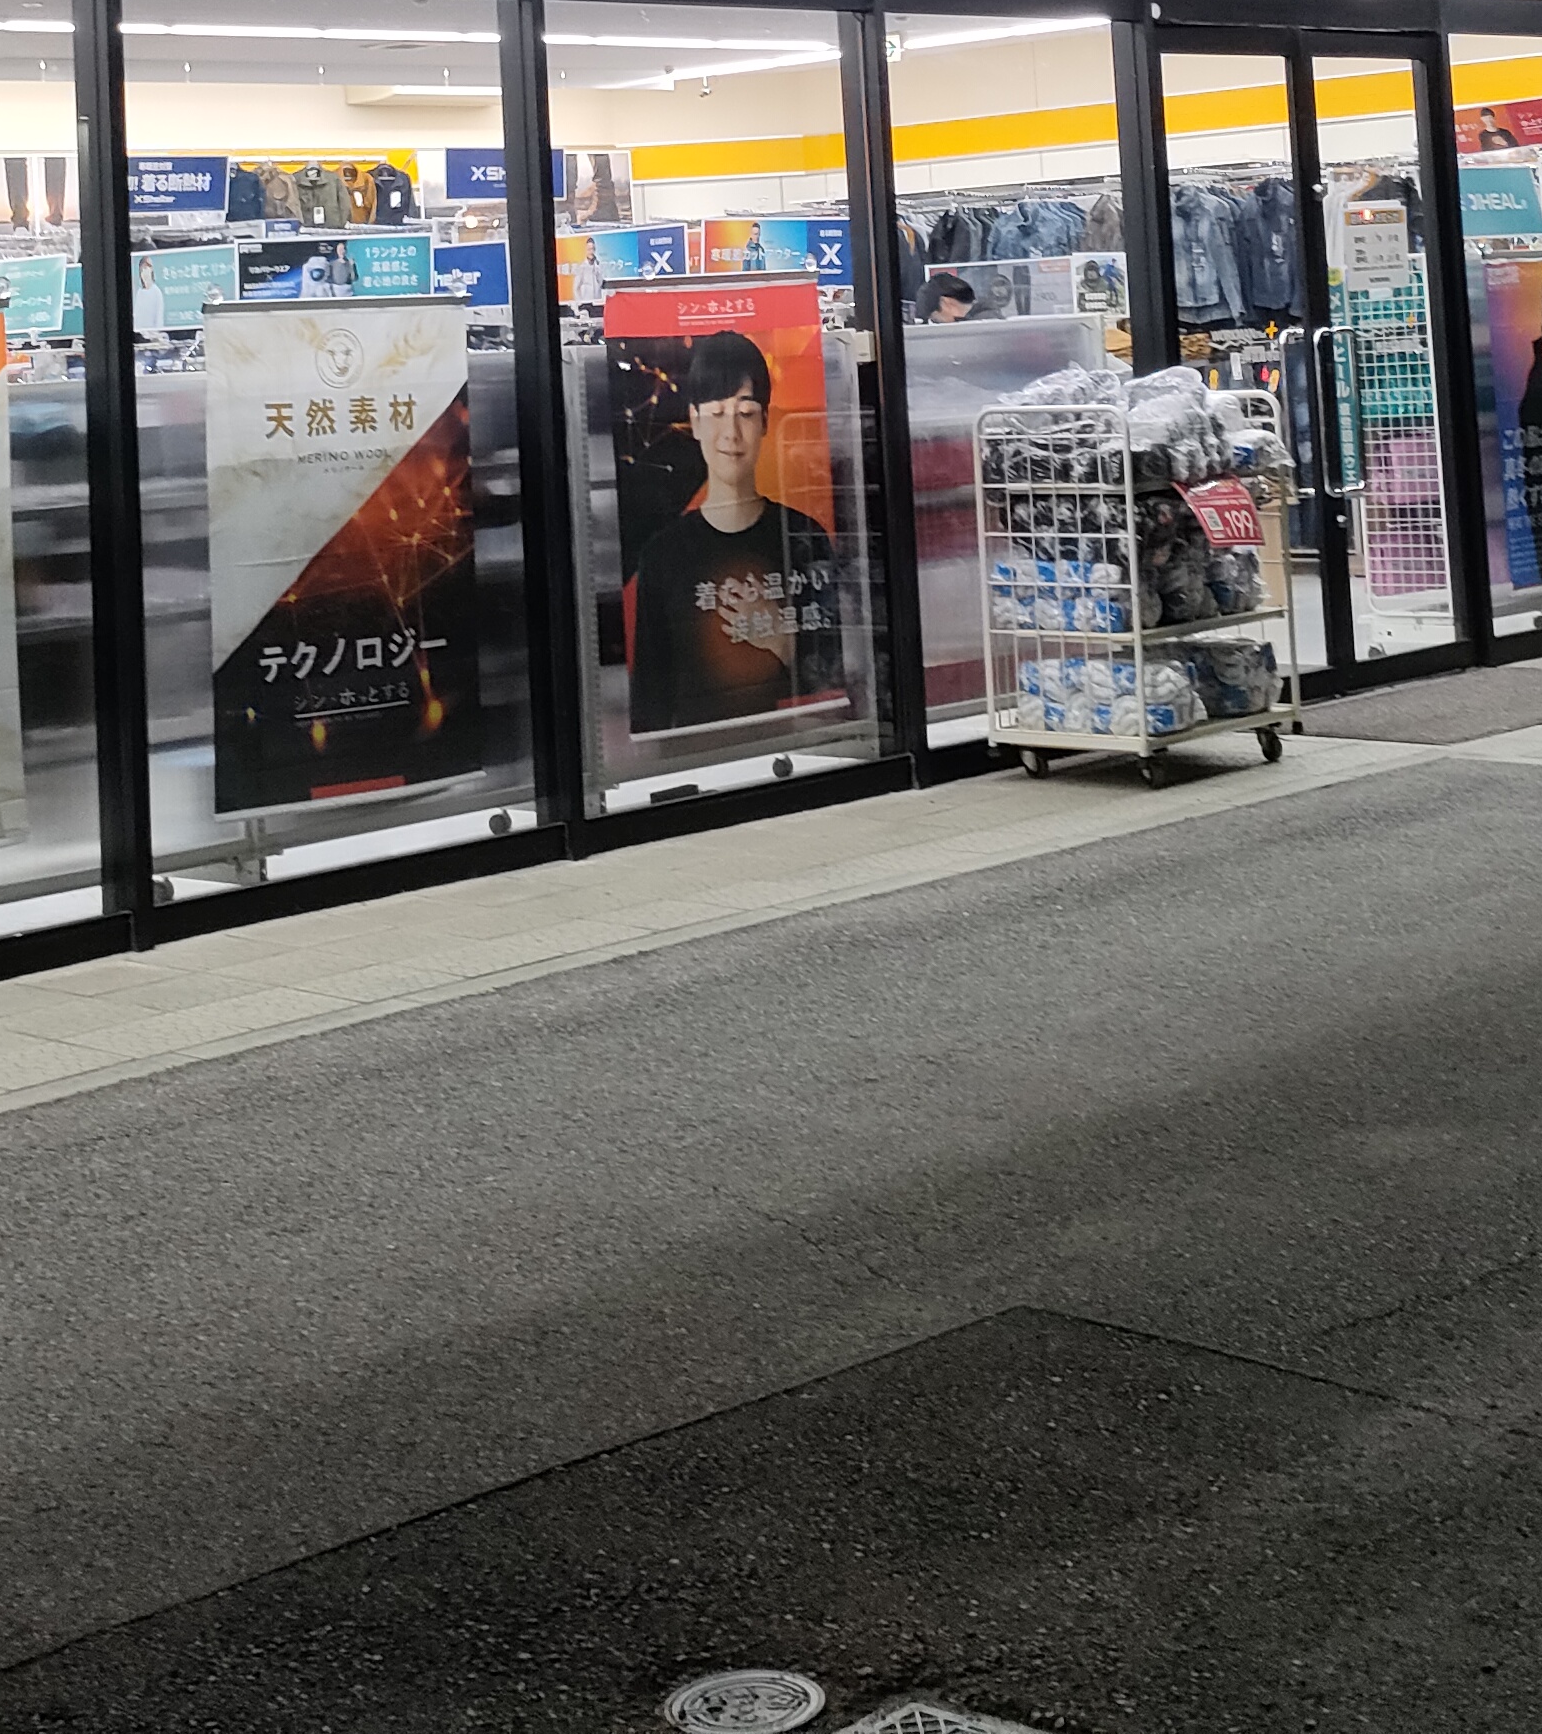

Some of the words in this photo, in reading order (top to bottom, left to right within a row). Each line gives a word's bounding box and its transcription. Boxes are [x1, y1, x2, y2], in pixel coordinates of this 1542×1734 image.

[264, 393, 417, 439] 天然素材
[297, 451, 349, 464] MERINO
[353, 449, 392, 460] WOOL
[259, 627, 448, 683] テクノロジー
